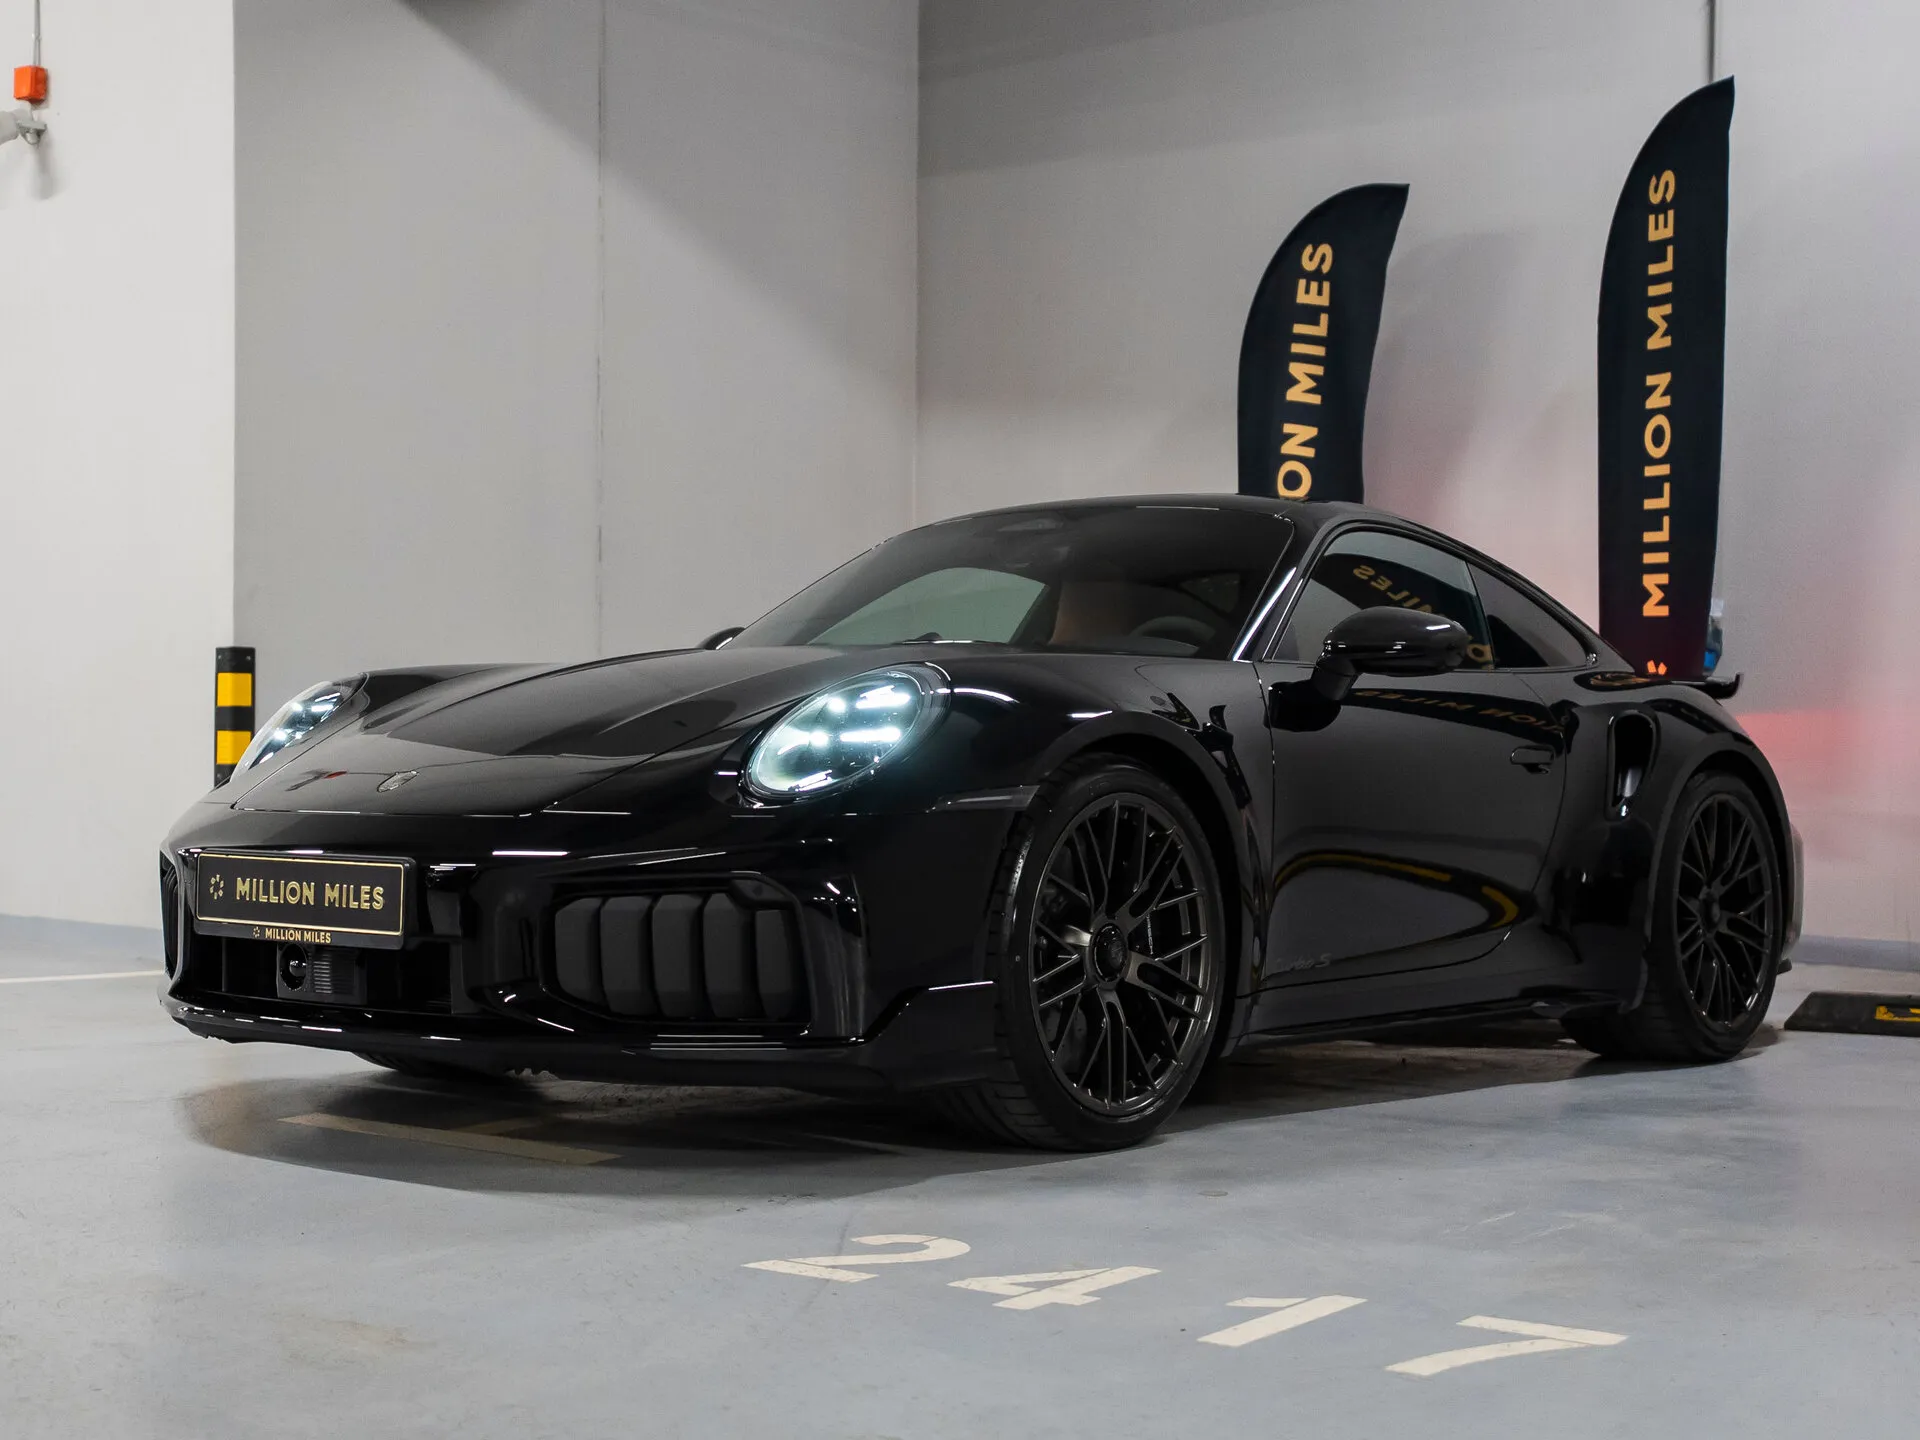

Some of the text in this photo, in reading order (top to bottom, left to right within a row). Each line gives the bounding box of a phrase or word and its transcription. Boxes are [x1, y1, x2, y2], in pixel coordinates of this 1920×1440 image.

[1286, 243, 1333, 405] MILES
[1642, 169, 1676, 618] MILLION MILES
[236, 877, 385, 911] MILLION MILES
[265, 927, 332, 944] MILLION MILES
